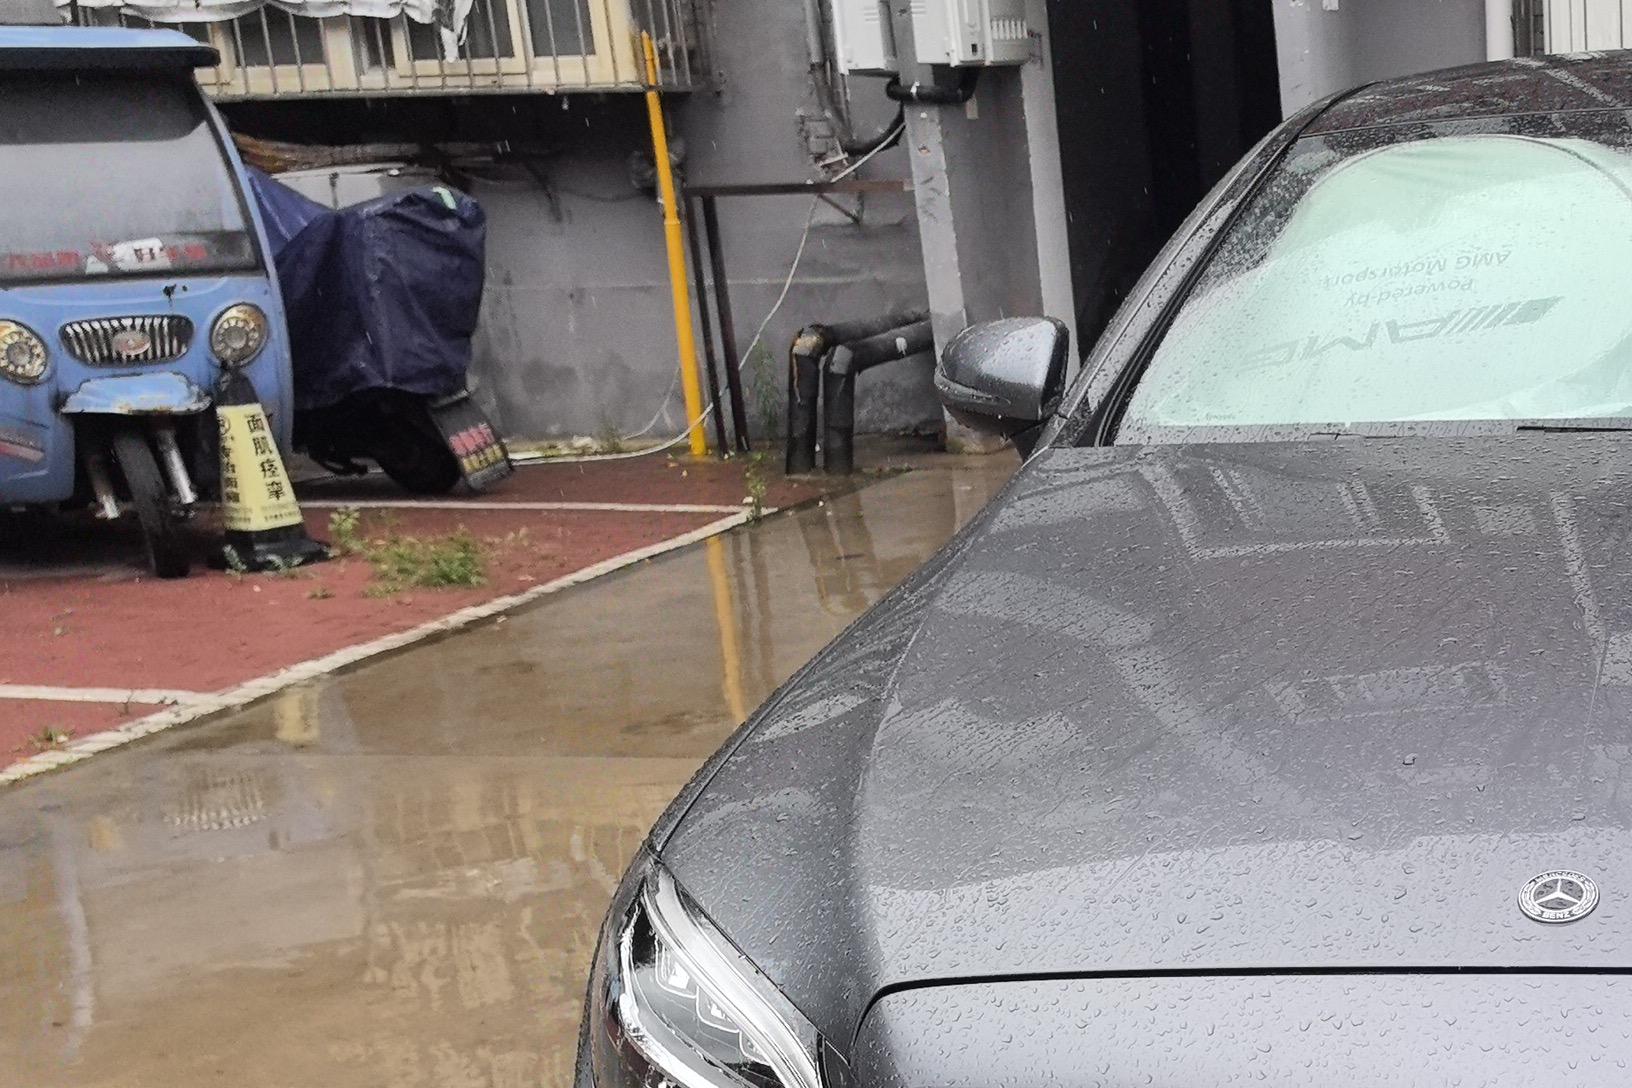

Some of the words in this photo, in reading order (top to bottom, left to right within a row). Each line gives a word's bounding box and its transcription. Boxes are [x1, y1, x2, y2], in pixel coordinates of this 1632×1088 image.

[1455, 251, 1512, 270] AMG
[1323, 257, 1448, 289] Motorsport
[1541, 910, 1572, 919] BENZ
